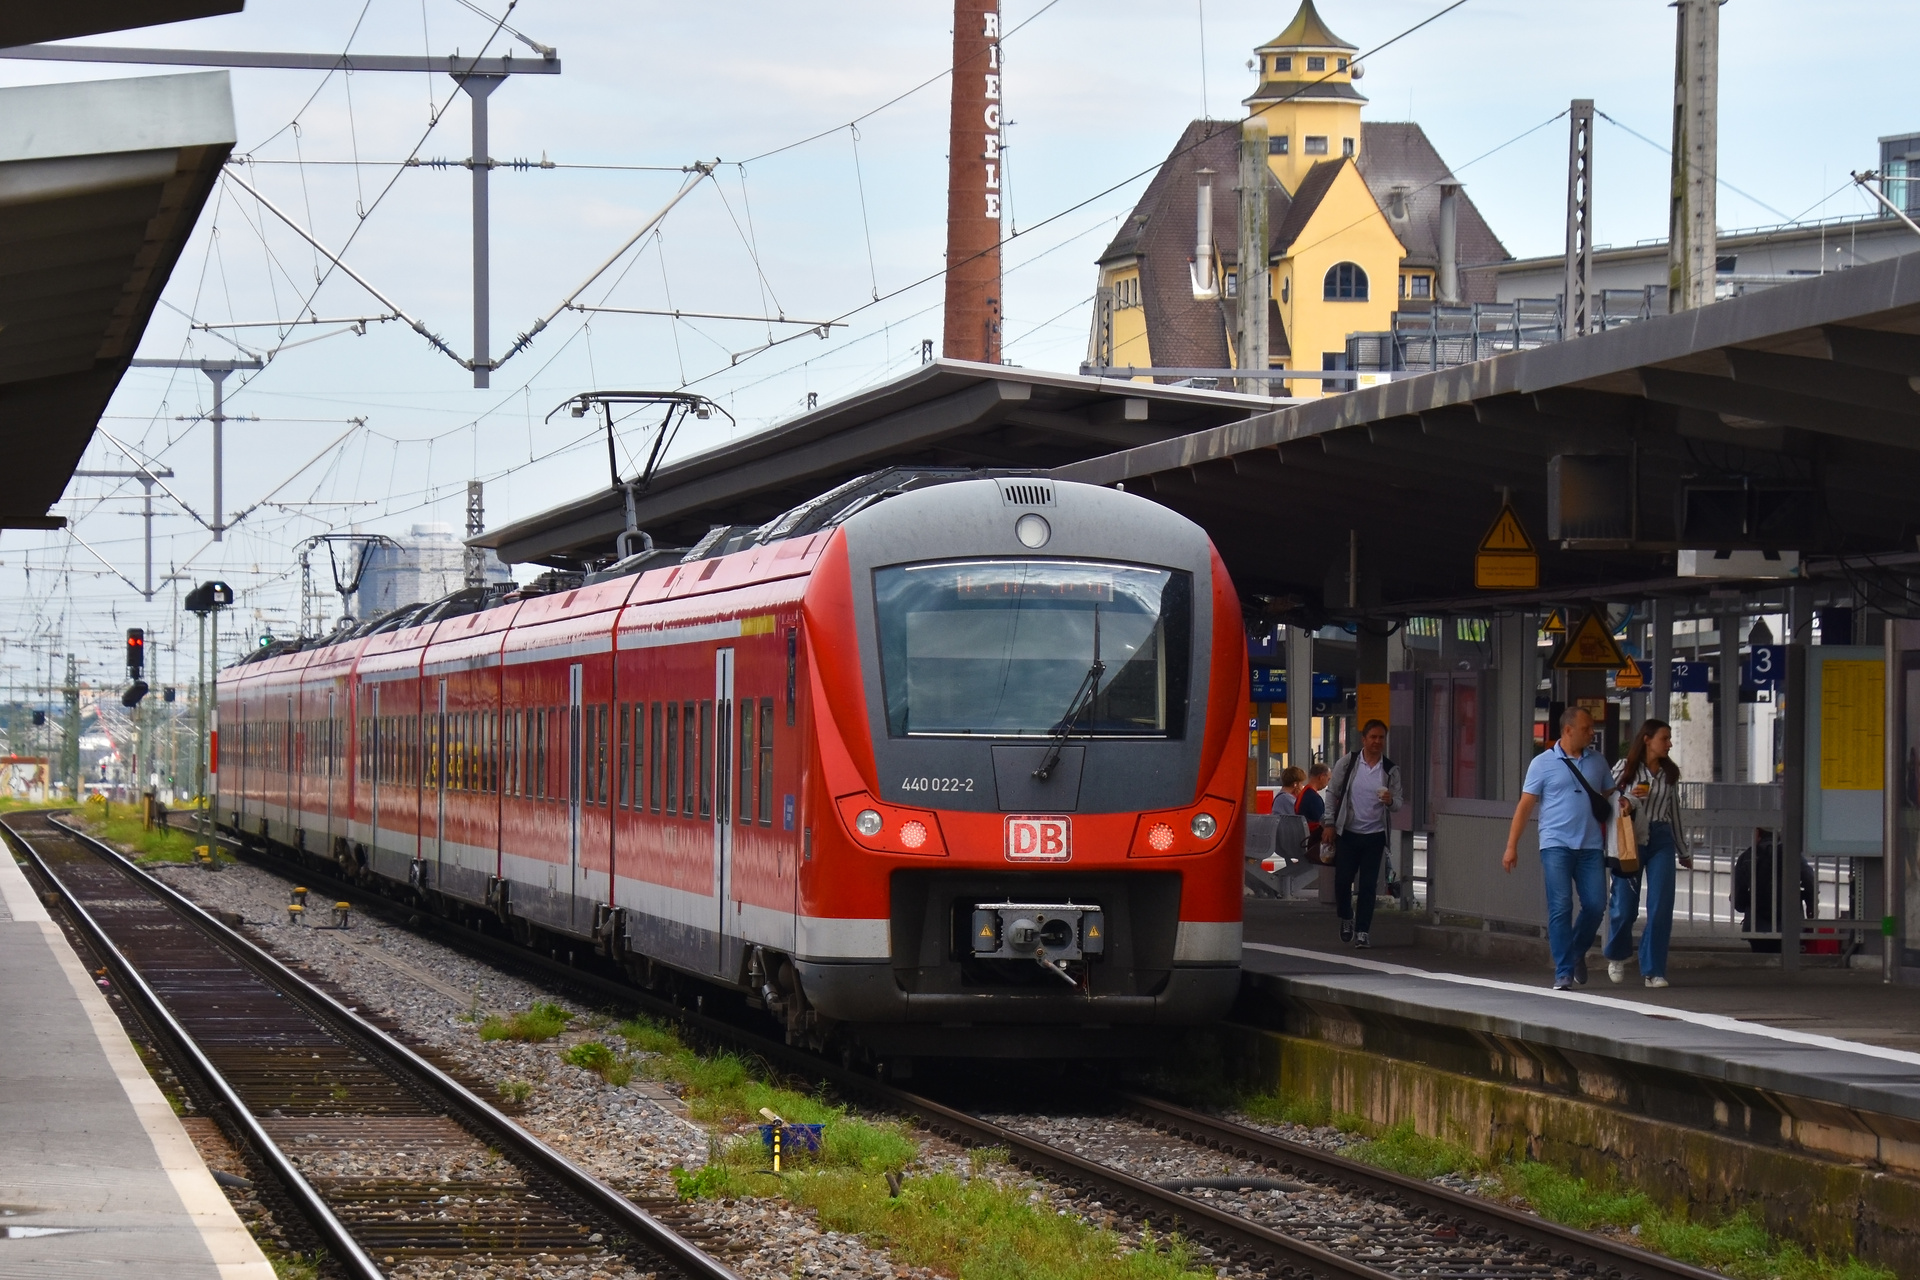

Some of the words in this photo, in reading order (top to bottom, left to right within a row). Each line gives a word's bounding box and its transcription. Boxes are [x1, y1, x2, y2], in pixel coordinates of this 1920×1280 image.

[984, 12, 999, 219] RIEGELE
[1755, 648, 1772, 673] 3
[1253, 669, 1259, 679] 3
[902, 778, 928, 792] 440
[931, 778, 974, 792] 022-2
[1013, 823, 1064, 854] DB
